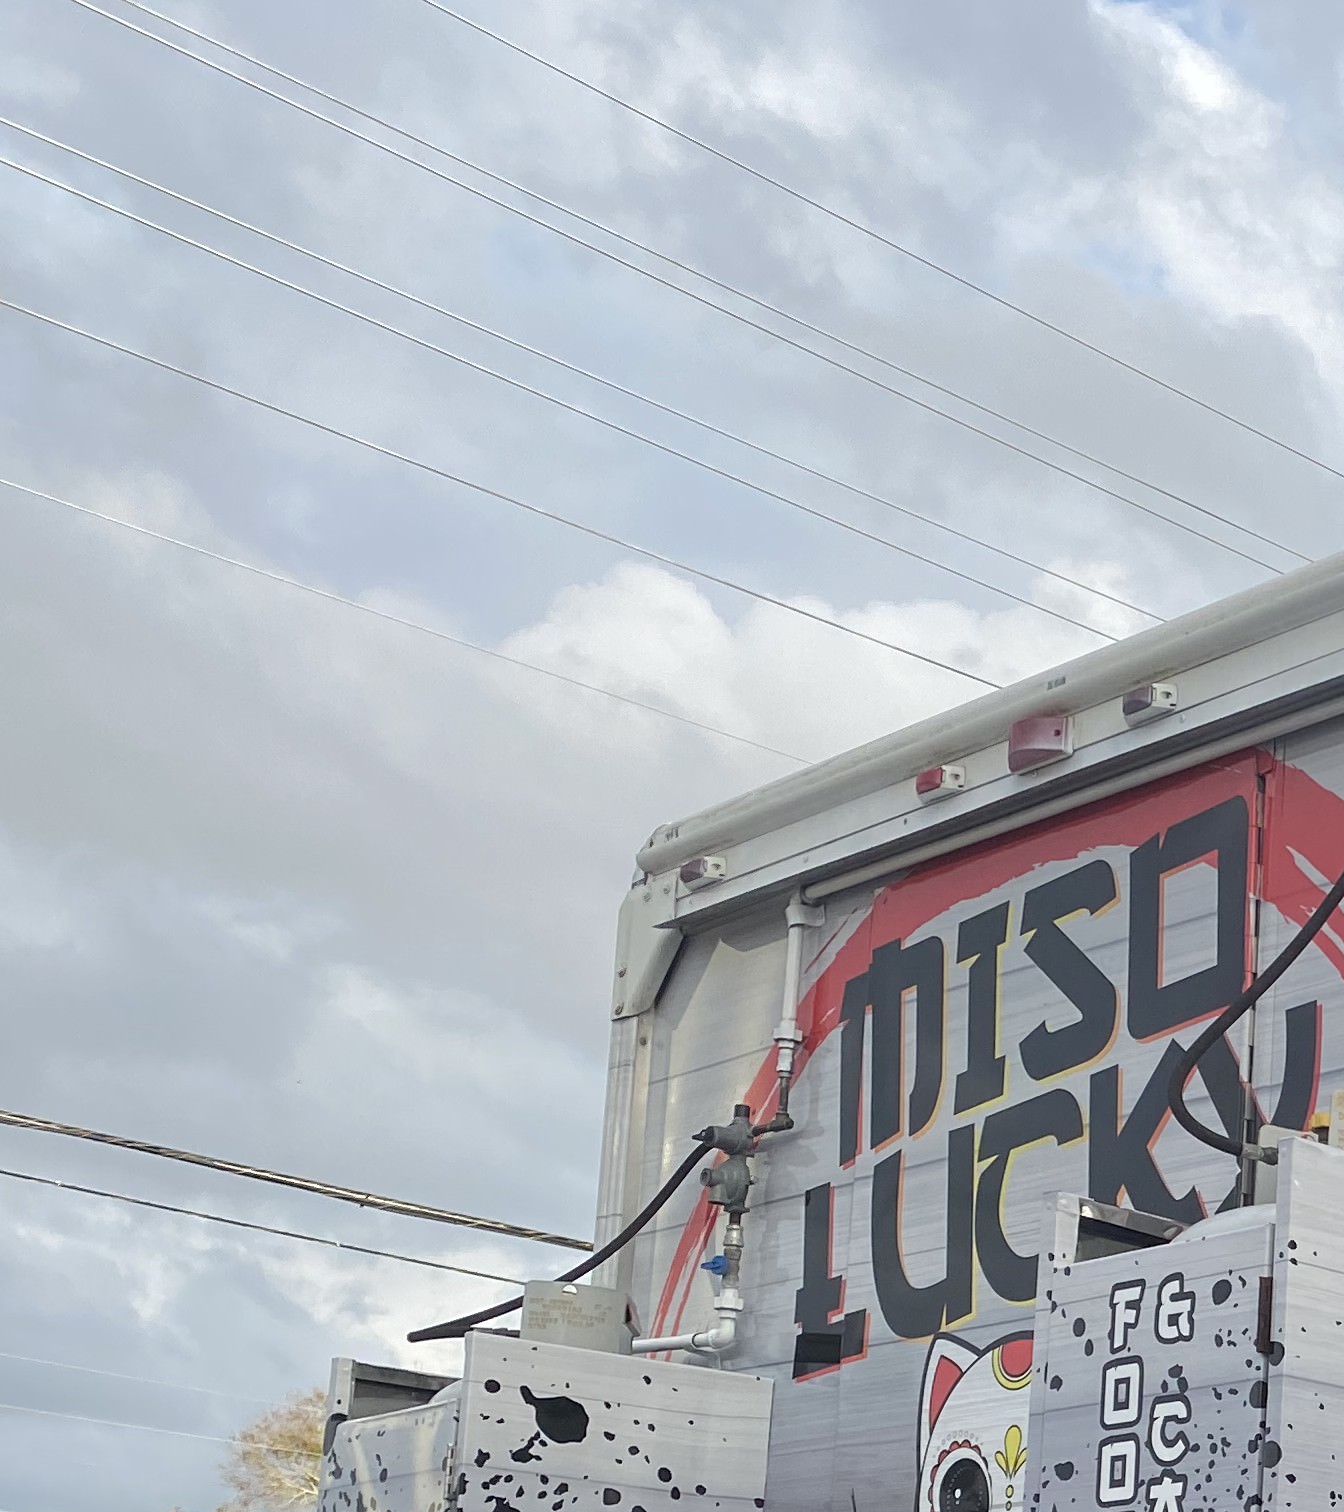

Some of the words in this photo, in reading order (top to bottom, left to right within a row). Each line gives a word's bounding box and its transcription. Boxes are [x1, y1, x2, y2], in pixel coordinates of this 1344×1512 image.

[839, 796, 1250, 1168] MISO
[793, 1001, 1320, 1380] LUCKY
[1155, 1272, 1196, 1346] &
